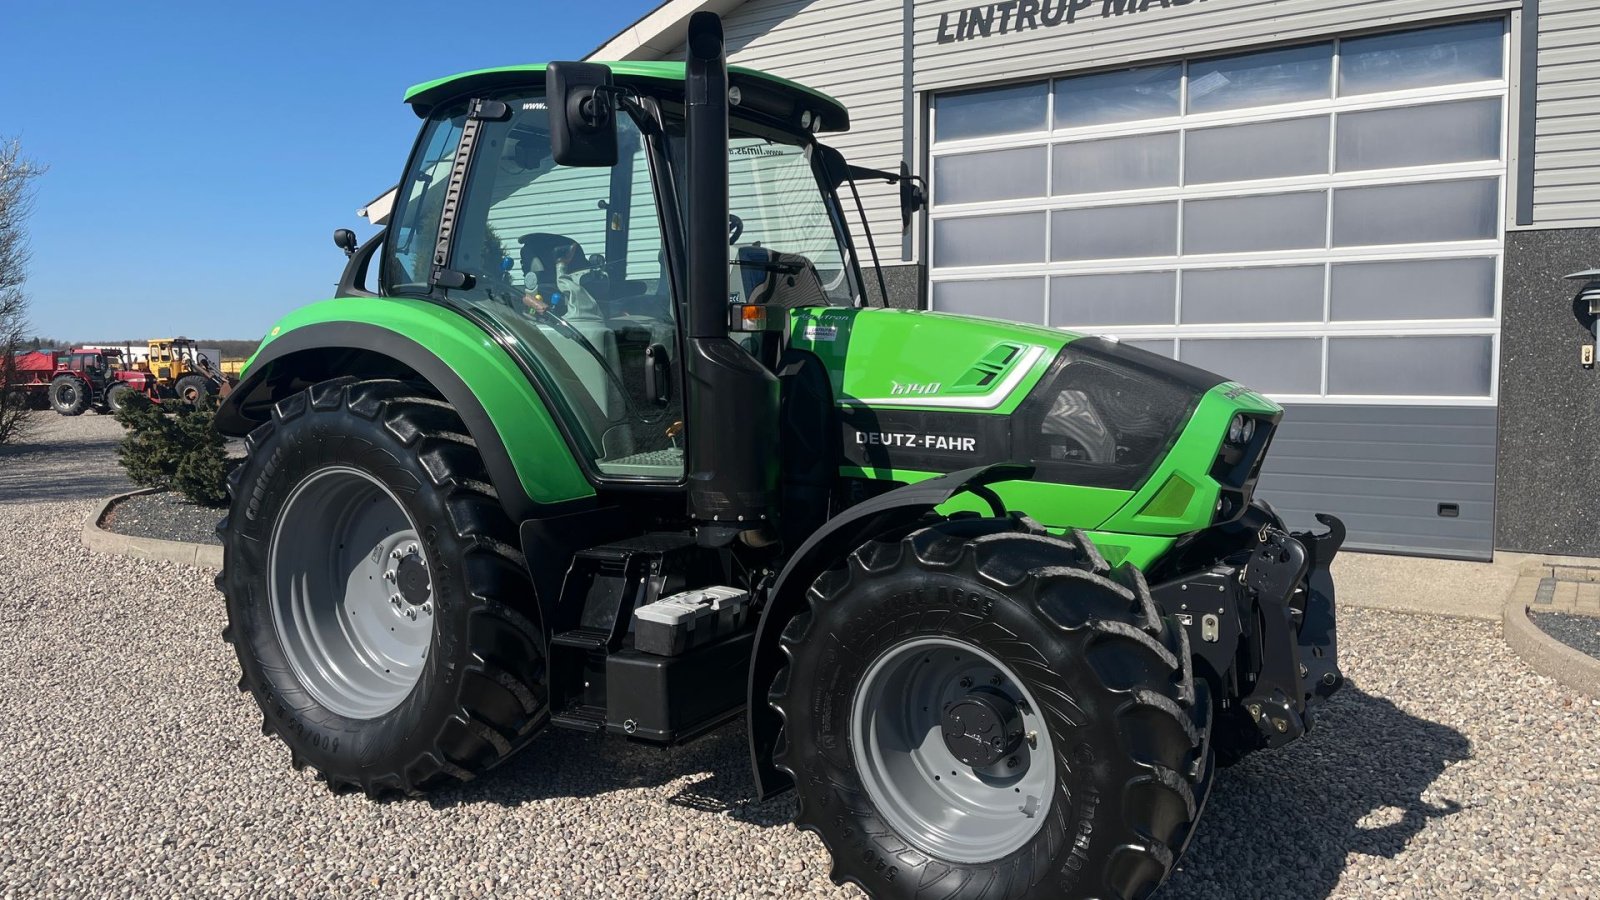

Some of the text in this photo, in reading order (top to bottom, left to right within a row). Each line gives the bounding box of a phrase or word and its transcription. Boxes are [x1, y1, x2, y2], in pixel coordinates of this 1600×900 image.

[936, 0, 1092, 44] LINTRUP
[891, 380, 941, 395] 6140
[855, 431, 976, 452] DEUTZ-FAHR
